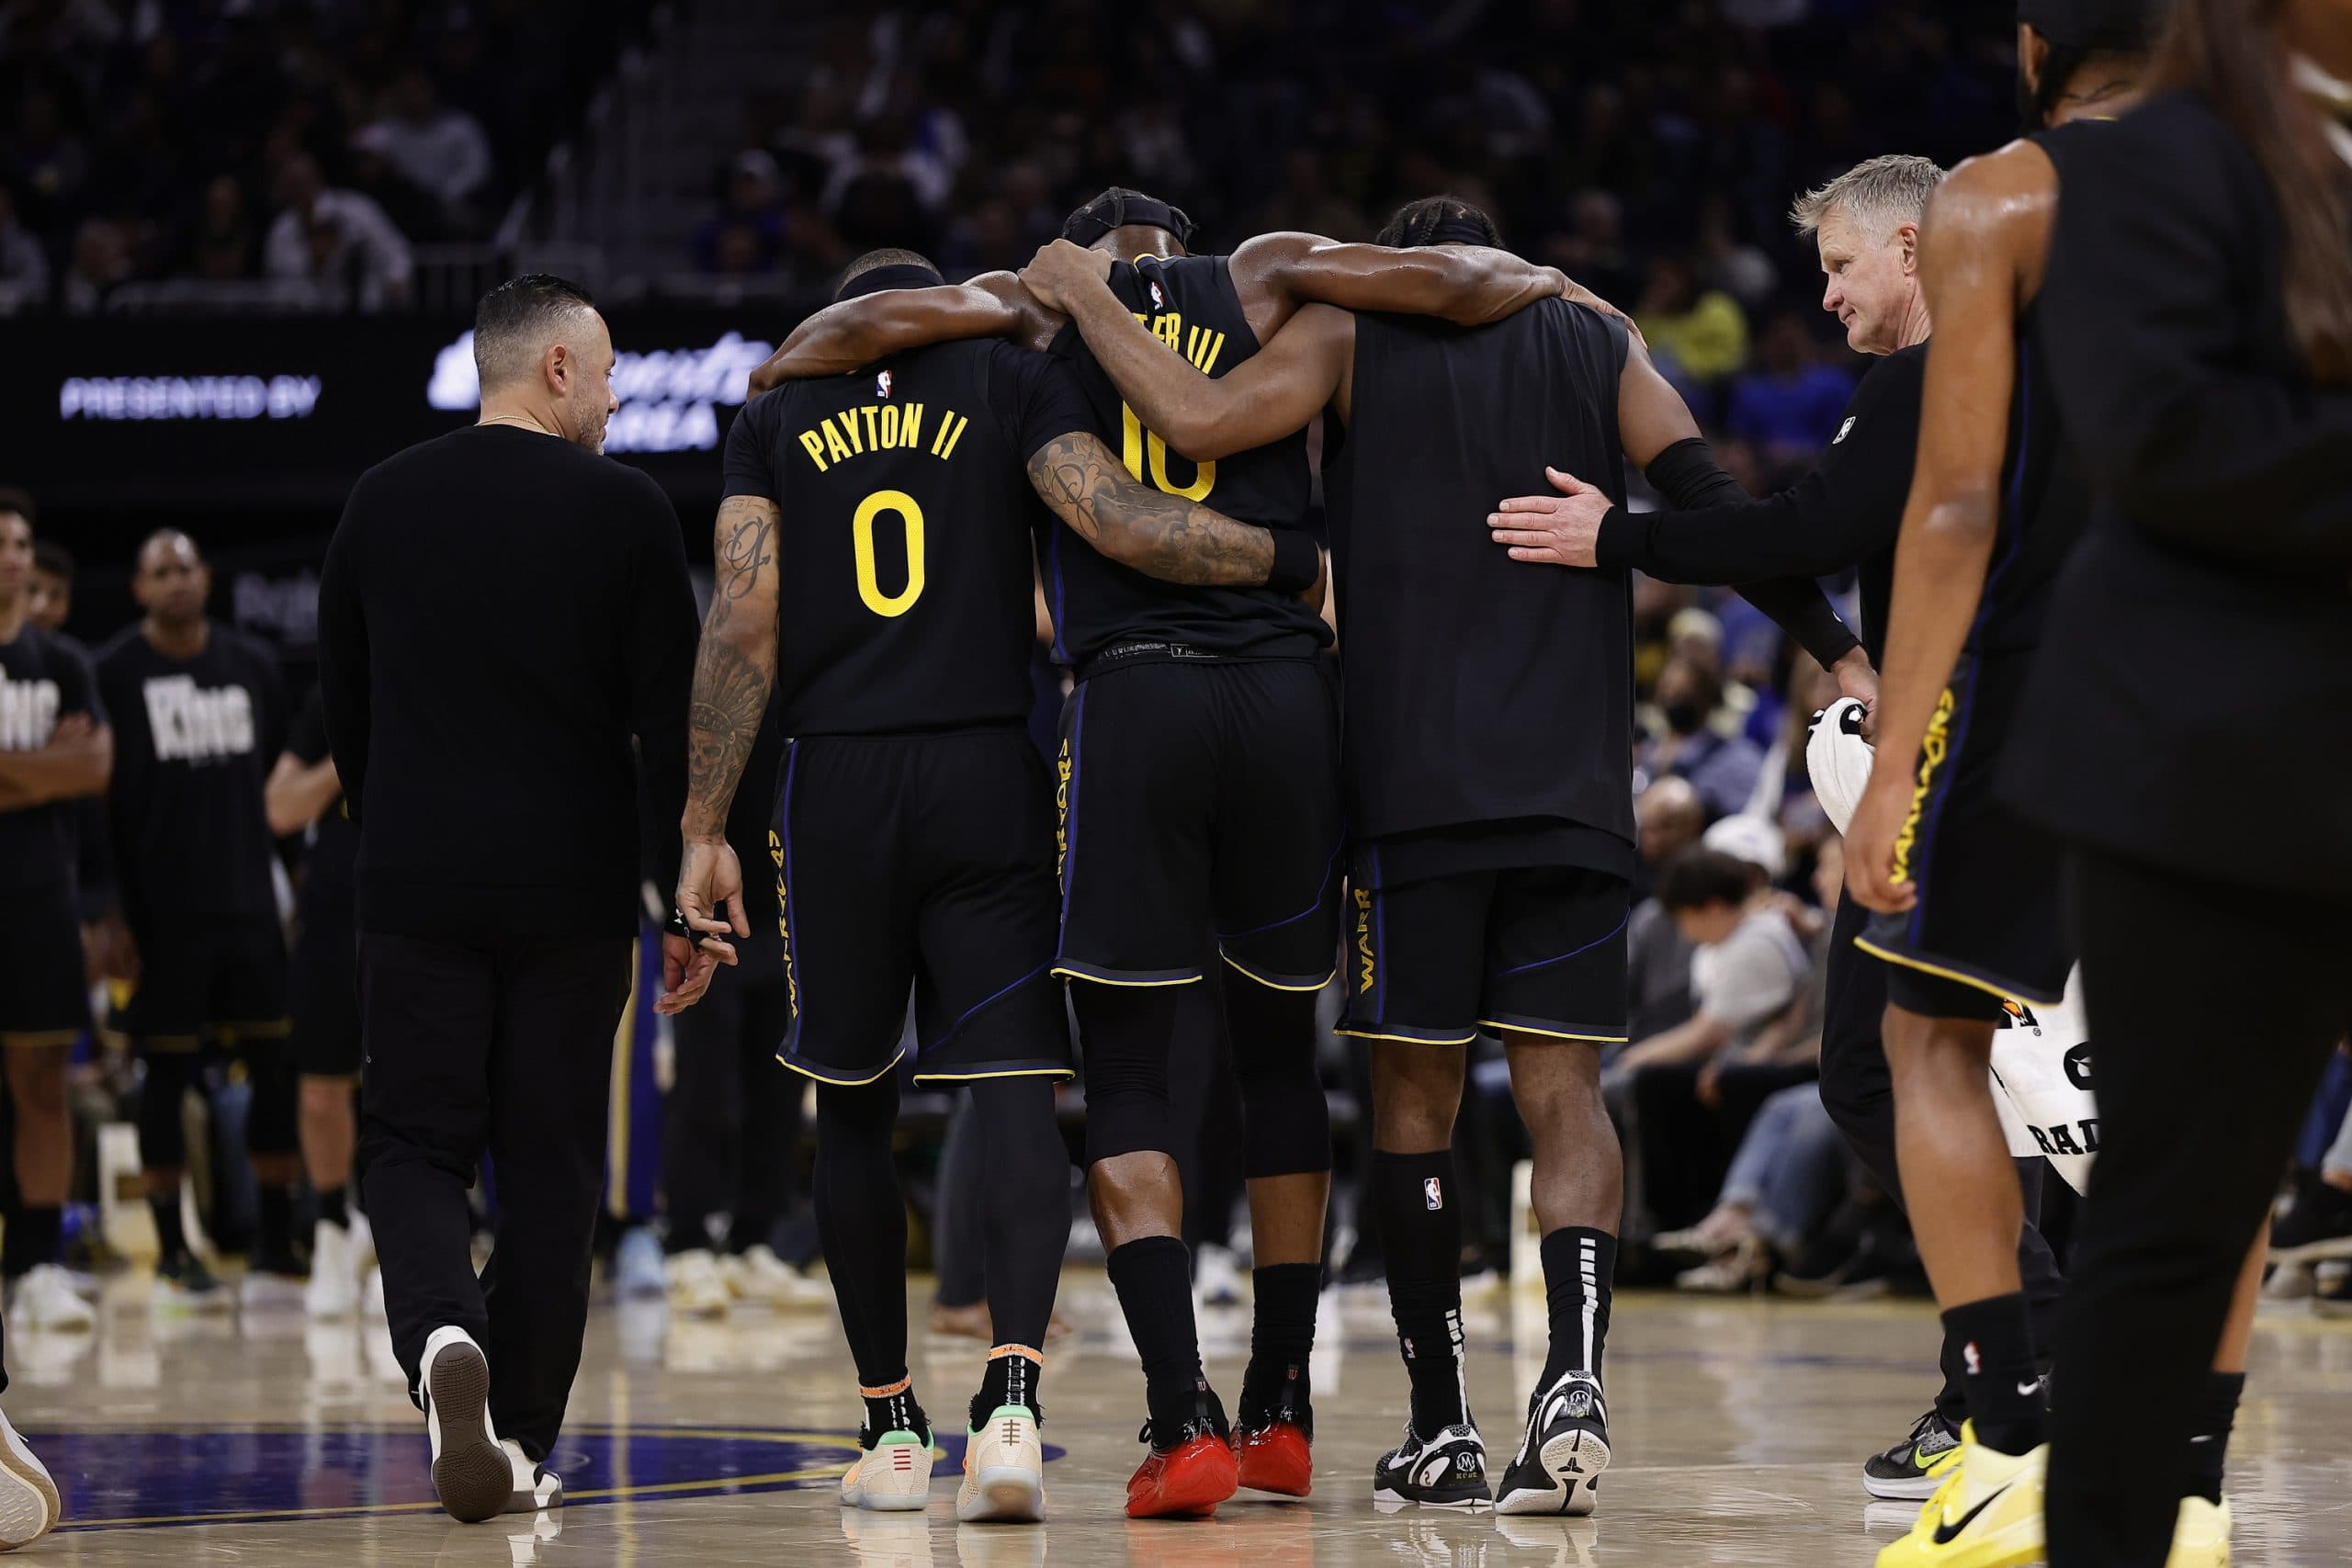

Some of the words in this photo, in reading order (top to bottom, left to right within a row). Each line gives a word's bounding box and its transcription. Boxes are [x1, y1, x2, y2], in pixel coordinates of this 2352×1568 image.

[60, 377, 266, 419] PRESENTED
[267, 375, 322, 419] BY
[798, 402, 924, 473] PAYTON
[931, 410, 968, 461] II
[853, 490, 925, 617] 0
